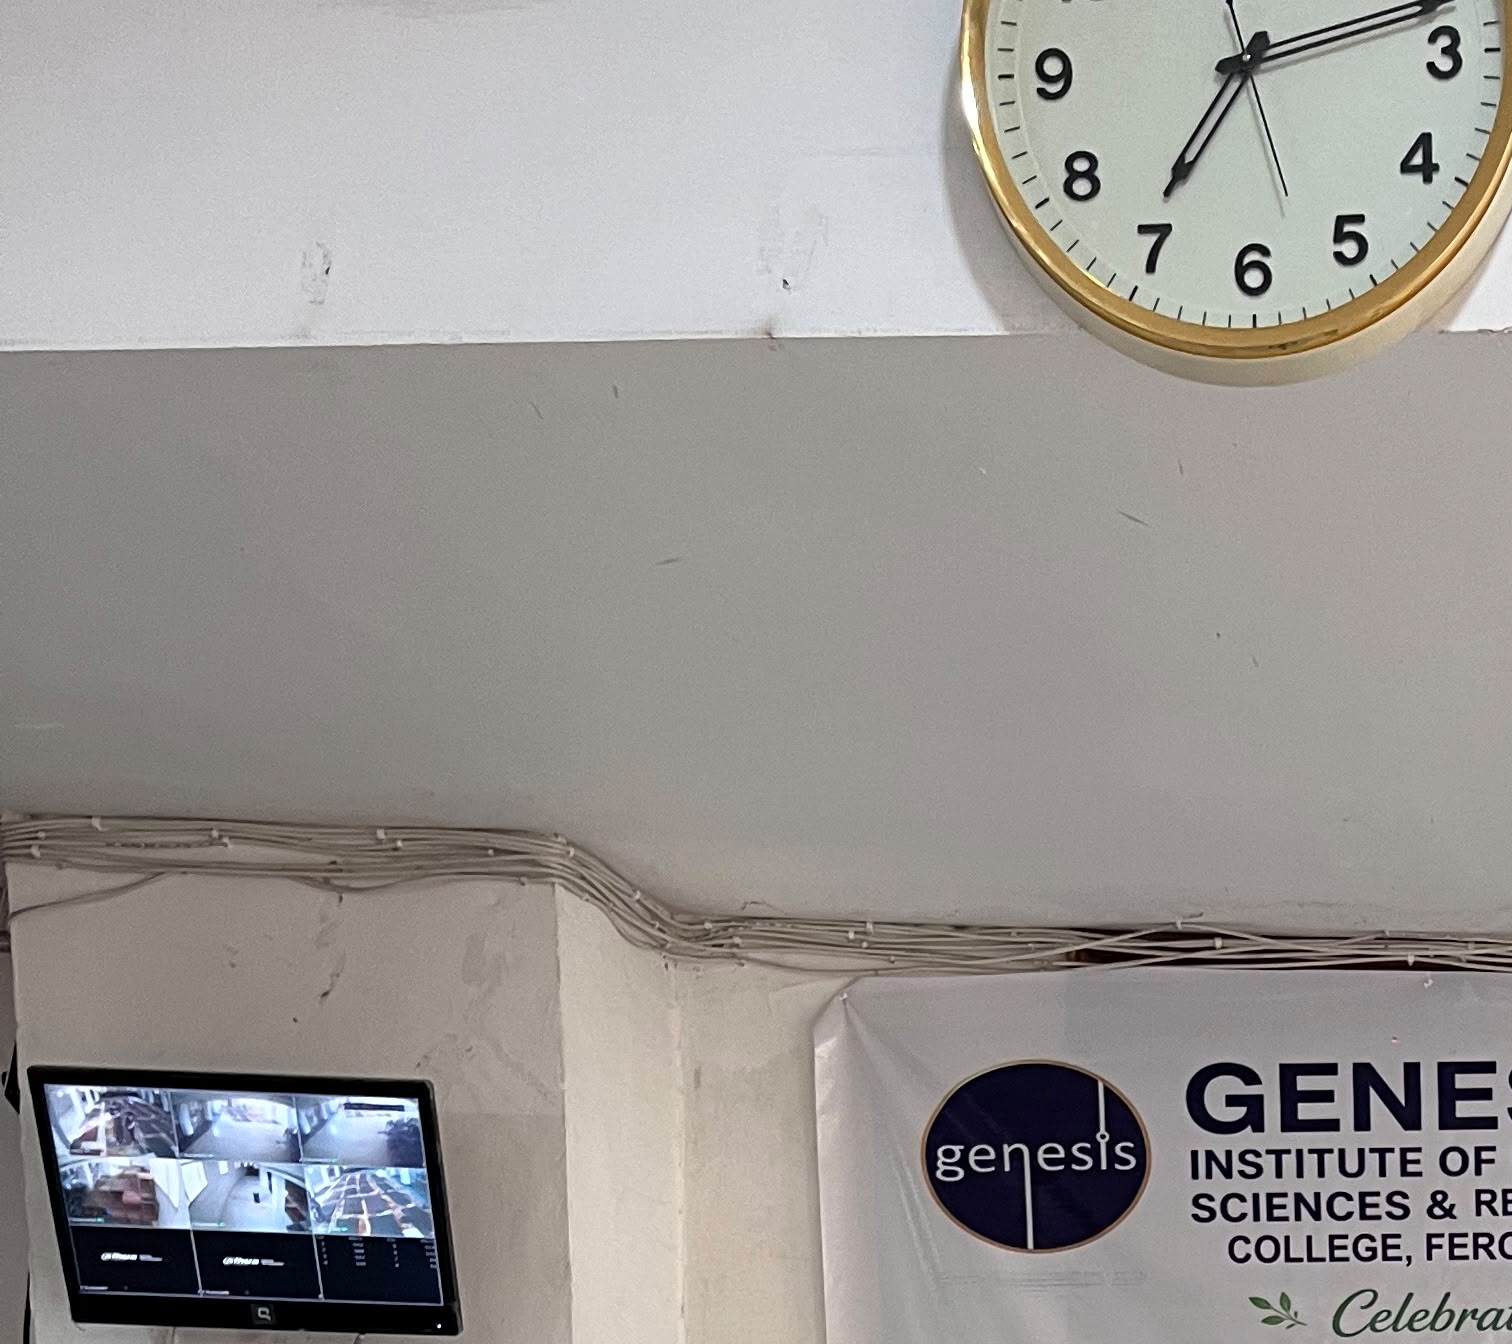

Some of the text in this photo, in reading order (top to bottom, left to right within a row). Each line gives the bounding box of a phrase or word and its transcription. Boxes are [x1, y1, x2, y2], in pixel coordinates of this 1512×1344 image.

[1034, 47, 1074, 101] 9
[1425, 25, 1463, 80] 3
[1063, 151, 1102, 202] 8
[1400, 131, 1440, 183] 4
[1137, 222, 1173, 274] 7
[1332, 213, 1370, 267] 5
[1233, 243, 1273, 296] 6
[1190, 1146, 1424, 1180] INSTITUTE
[1438, 1145, 1497, 1178] OF
[1191, 1188, 1412, 1224] SCIENCES
[1425, 1188, 1458, 1220] &
[1228, 1232, 1415, 1267] COLLEGE,
